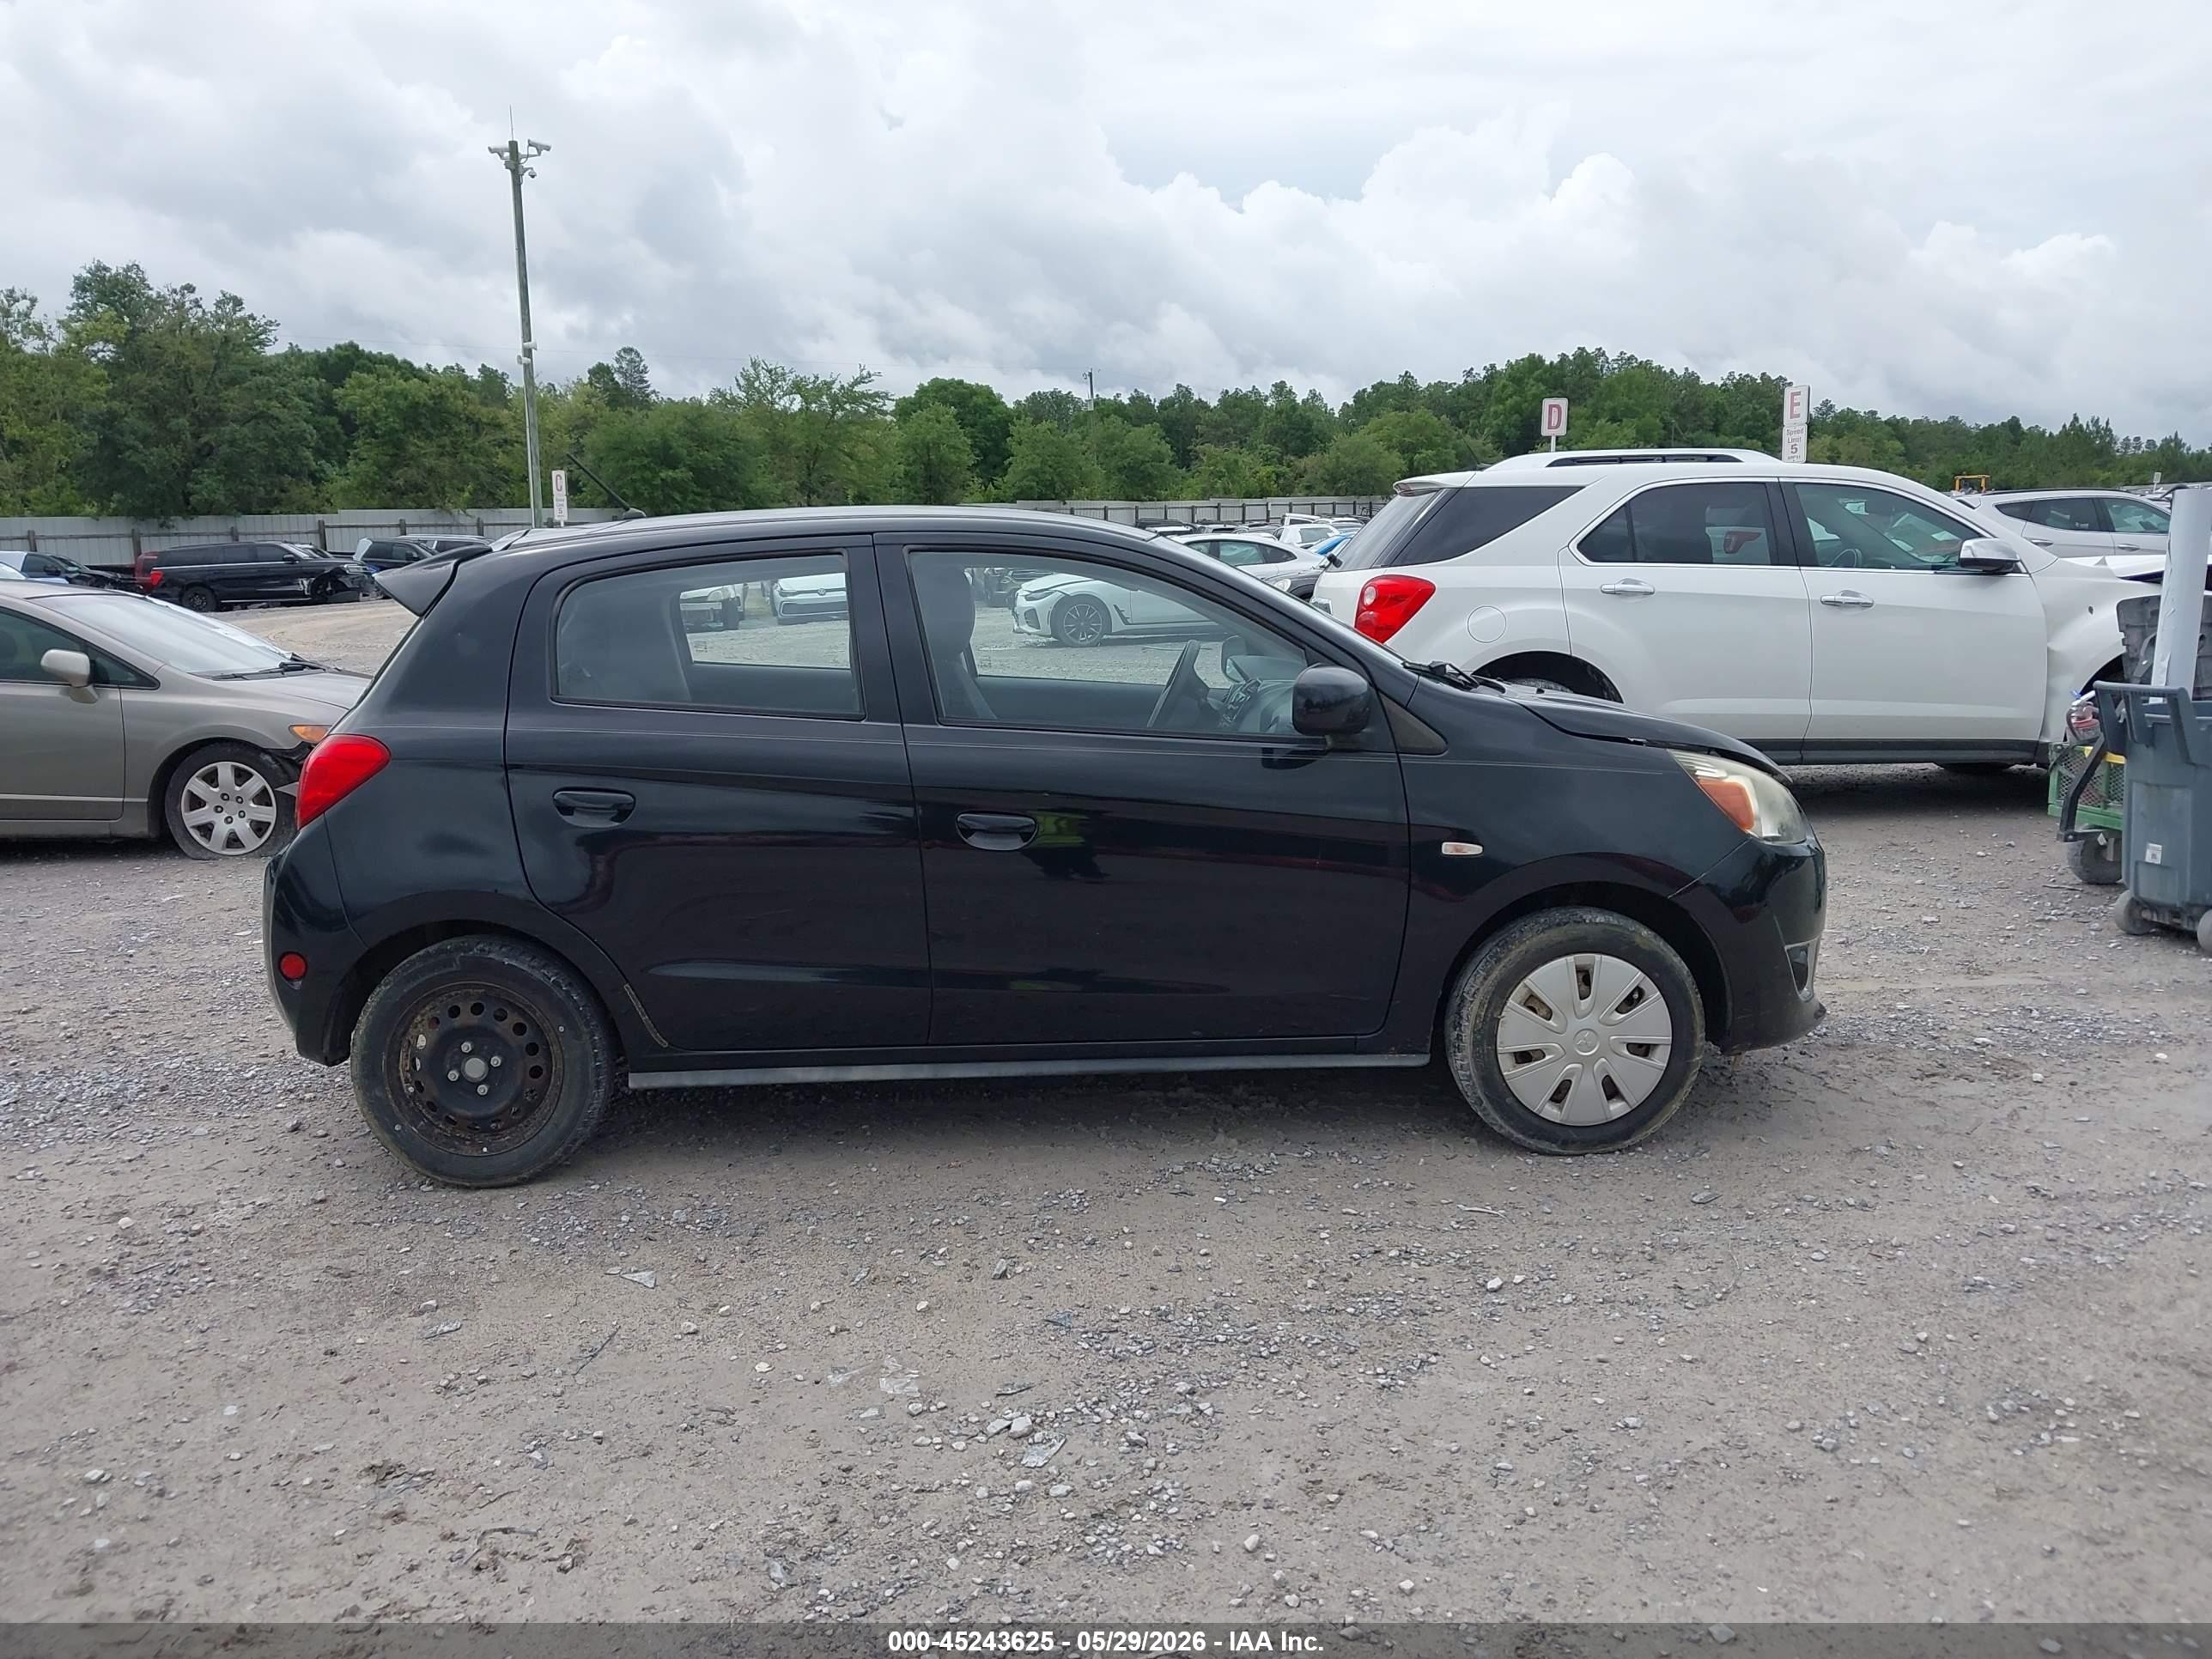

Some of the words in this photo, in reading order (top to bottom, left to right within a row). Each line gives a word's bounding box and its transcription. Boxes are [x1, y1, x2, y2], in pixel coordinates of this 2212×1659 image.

[1790, 392, 1802, 419] E
[1547, 404, 1562, 429] D
[1790, 444, 1798, 454] 5
[556, 474, 562, 492] C
